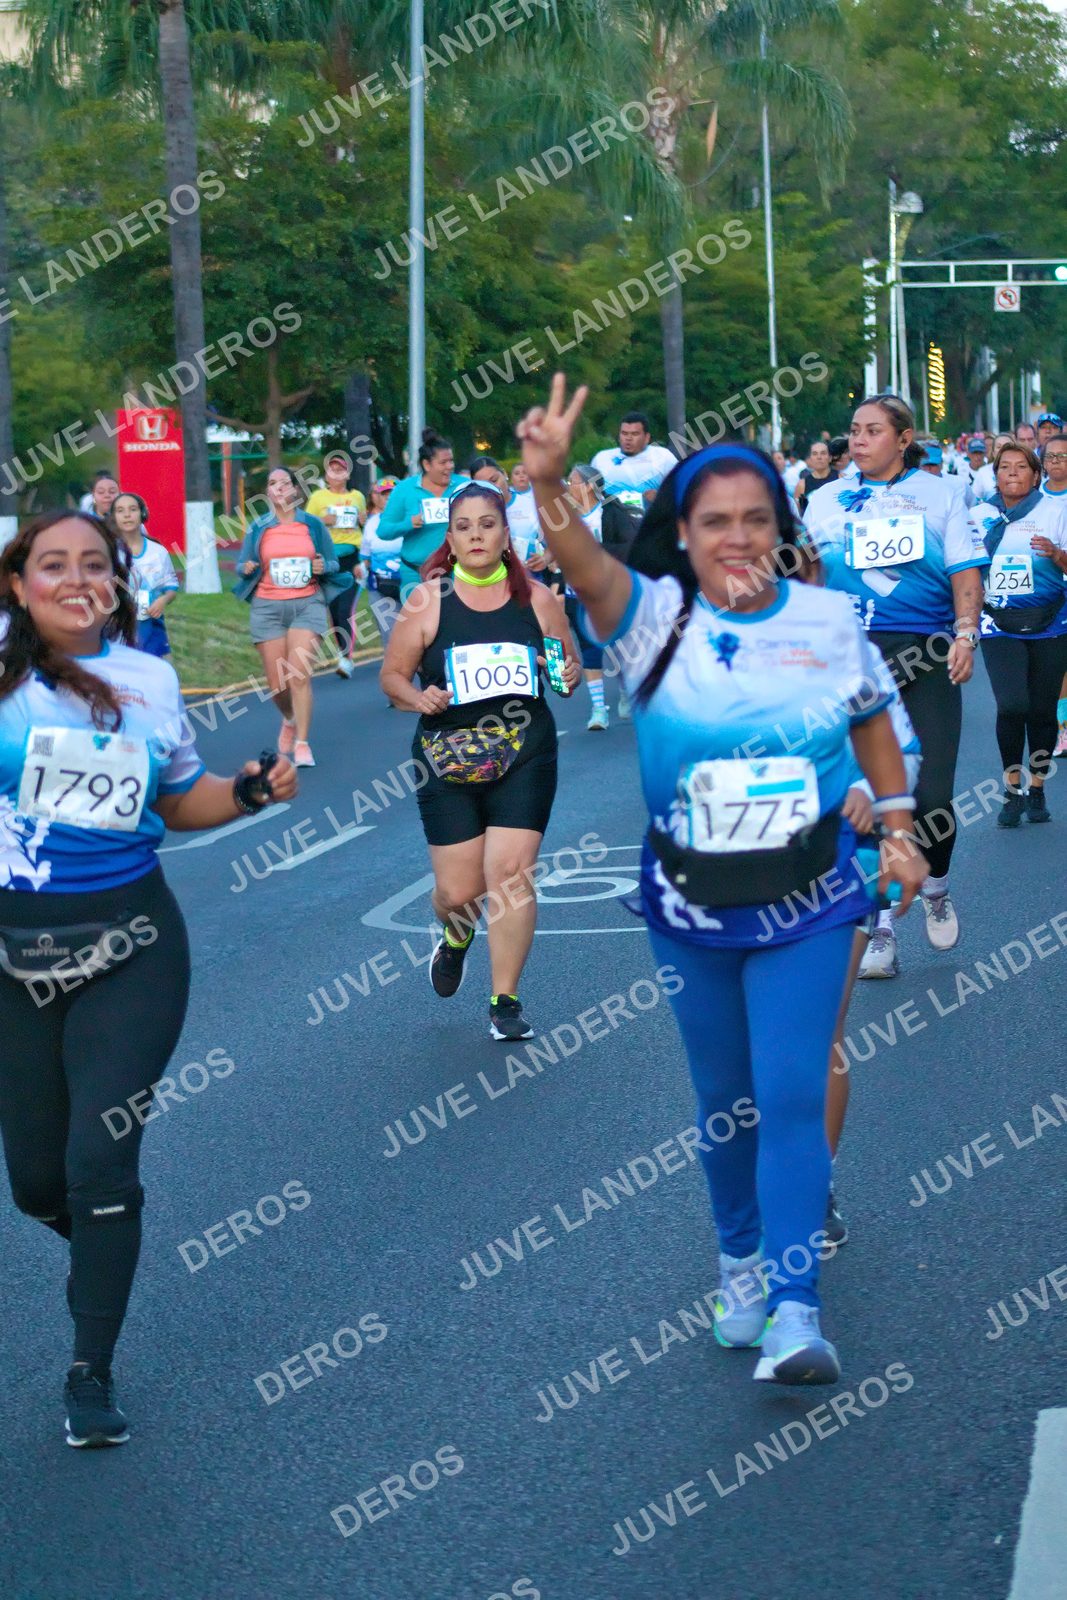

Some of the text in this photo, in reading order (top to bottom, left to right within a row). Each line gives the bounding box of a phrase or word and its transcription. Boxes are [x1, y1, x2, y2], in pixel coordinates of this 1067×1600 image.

[124, 441, 181, 452] HONDA
[865, 536, 913, 561] 360
[274, 570, 309, 585] 1876
[459, 665, 529, 694] 1005
[33, 766, 142, 818] 1793
[702, 799, 807, 841] 1775
